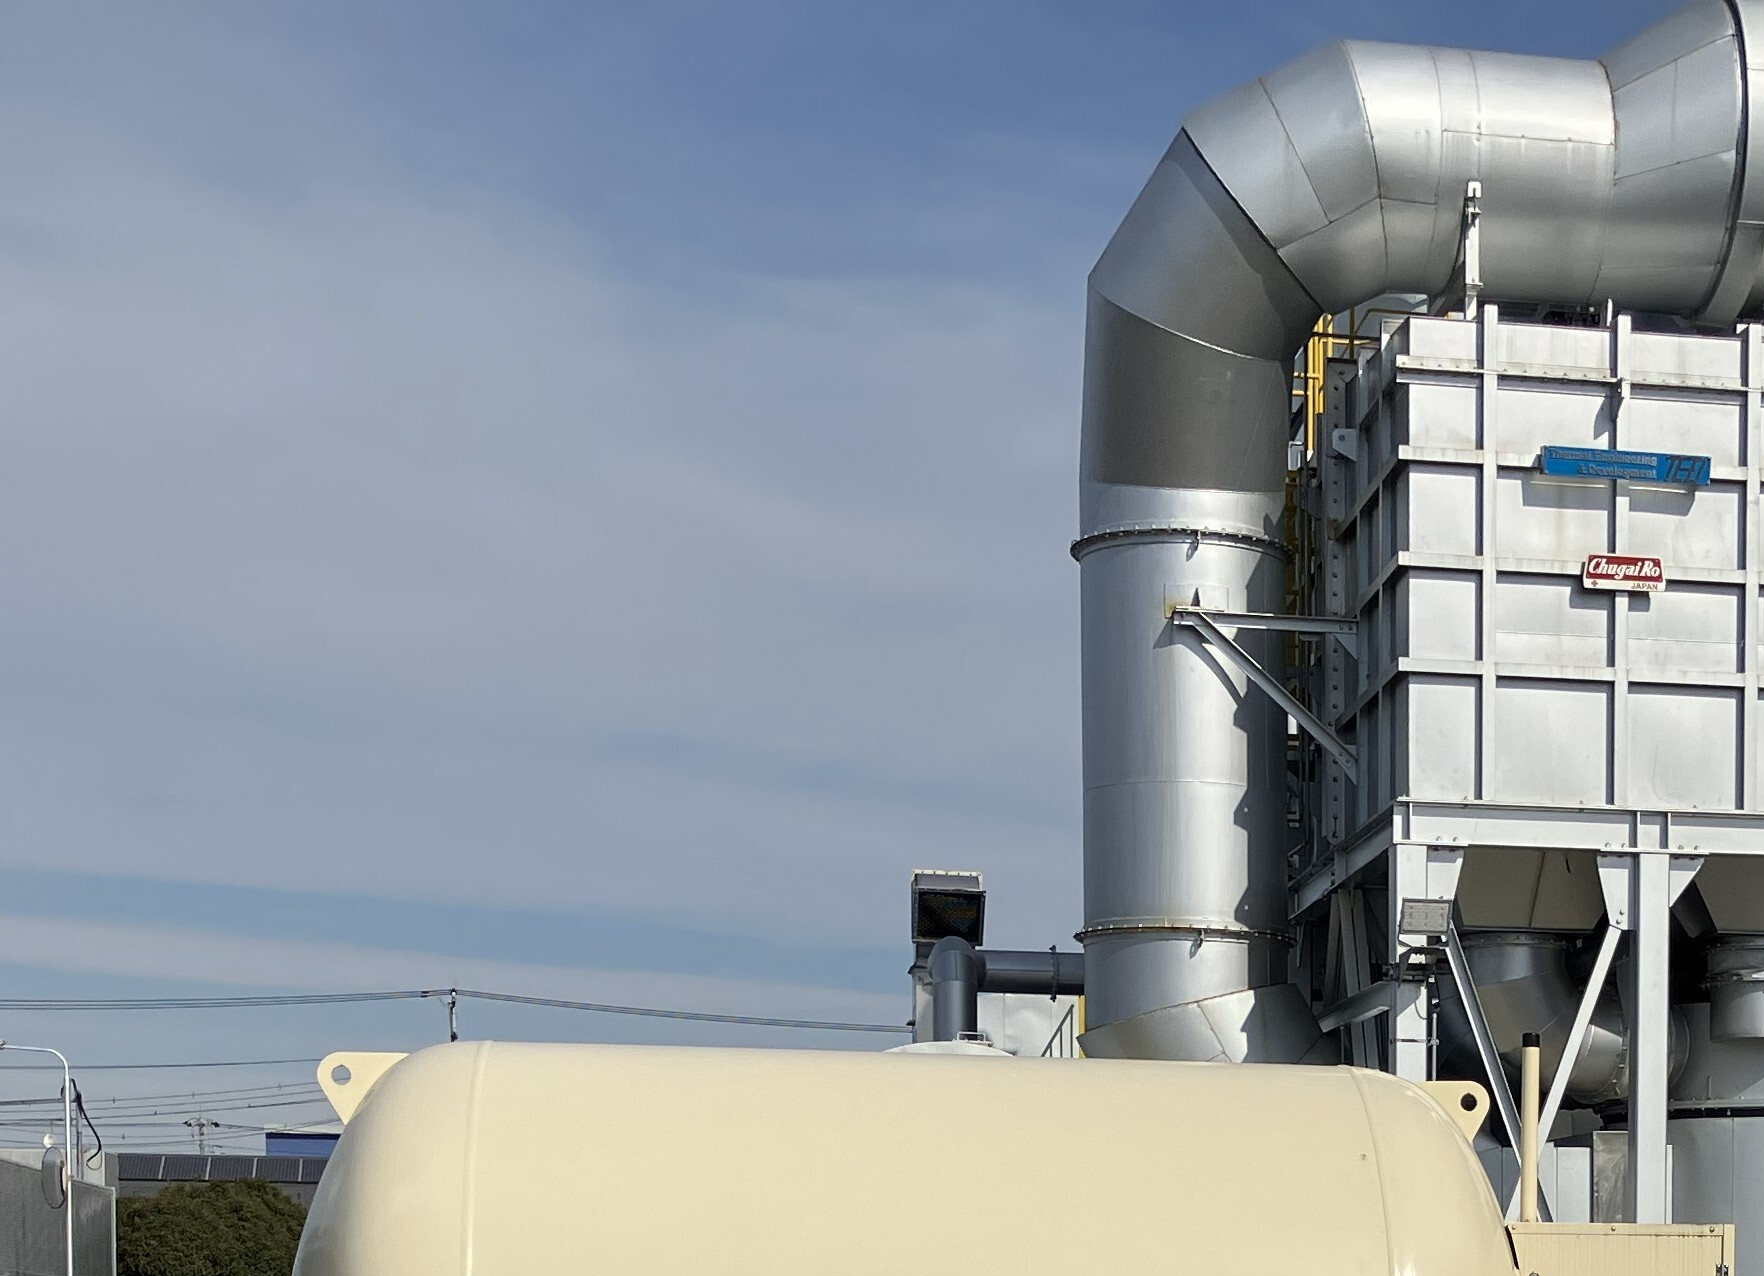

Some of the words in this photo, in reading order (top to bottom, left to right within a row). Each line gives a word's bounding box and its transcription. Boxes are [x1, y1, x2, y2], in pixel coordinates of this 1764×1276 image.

[1594, 450, 1657, 467] Engineering
[1588, 464, 1657, 480] Development
[1631, 582, 1658, 591] JAPAN
